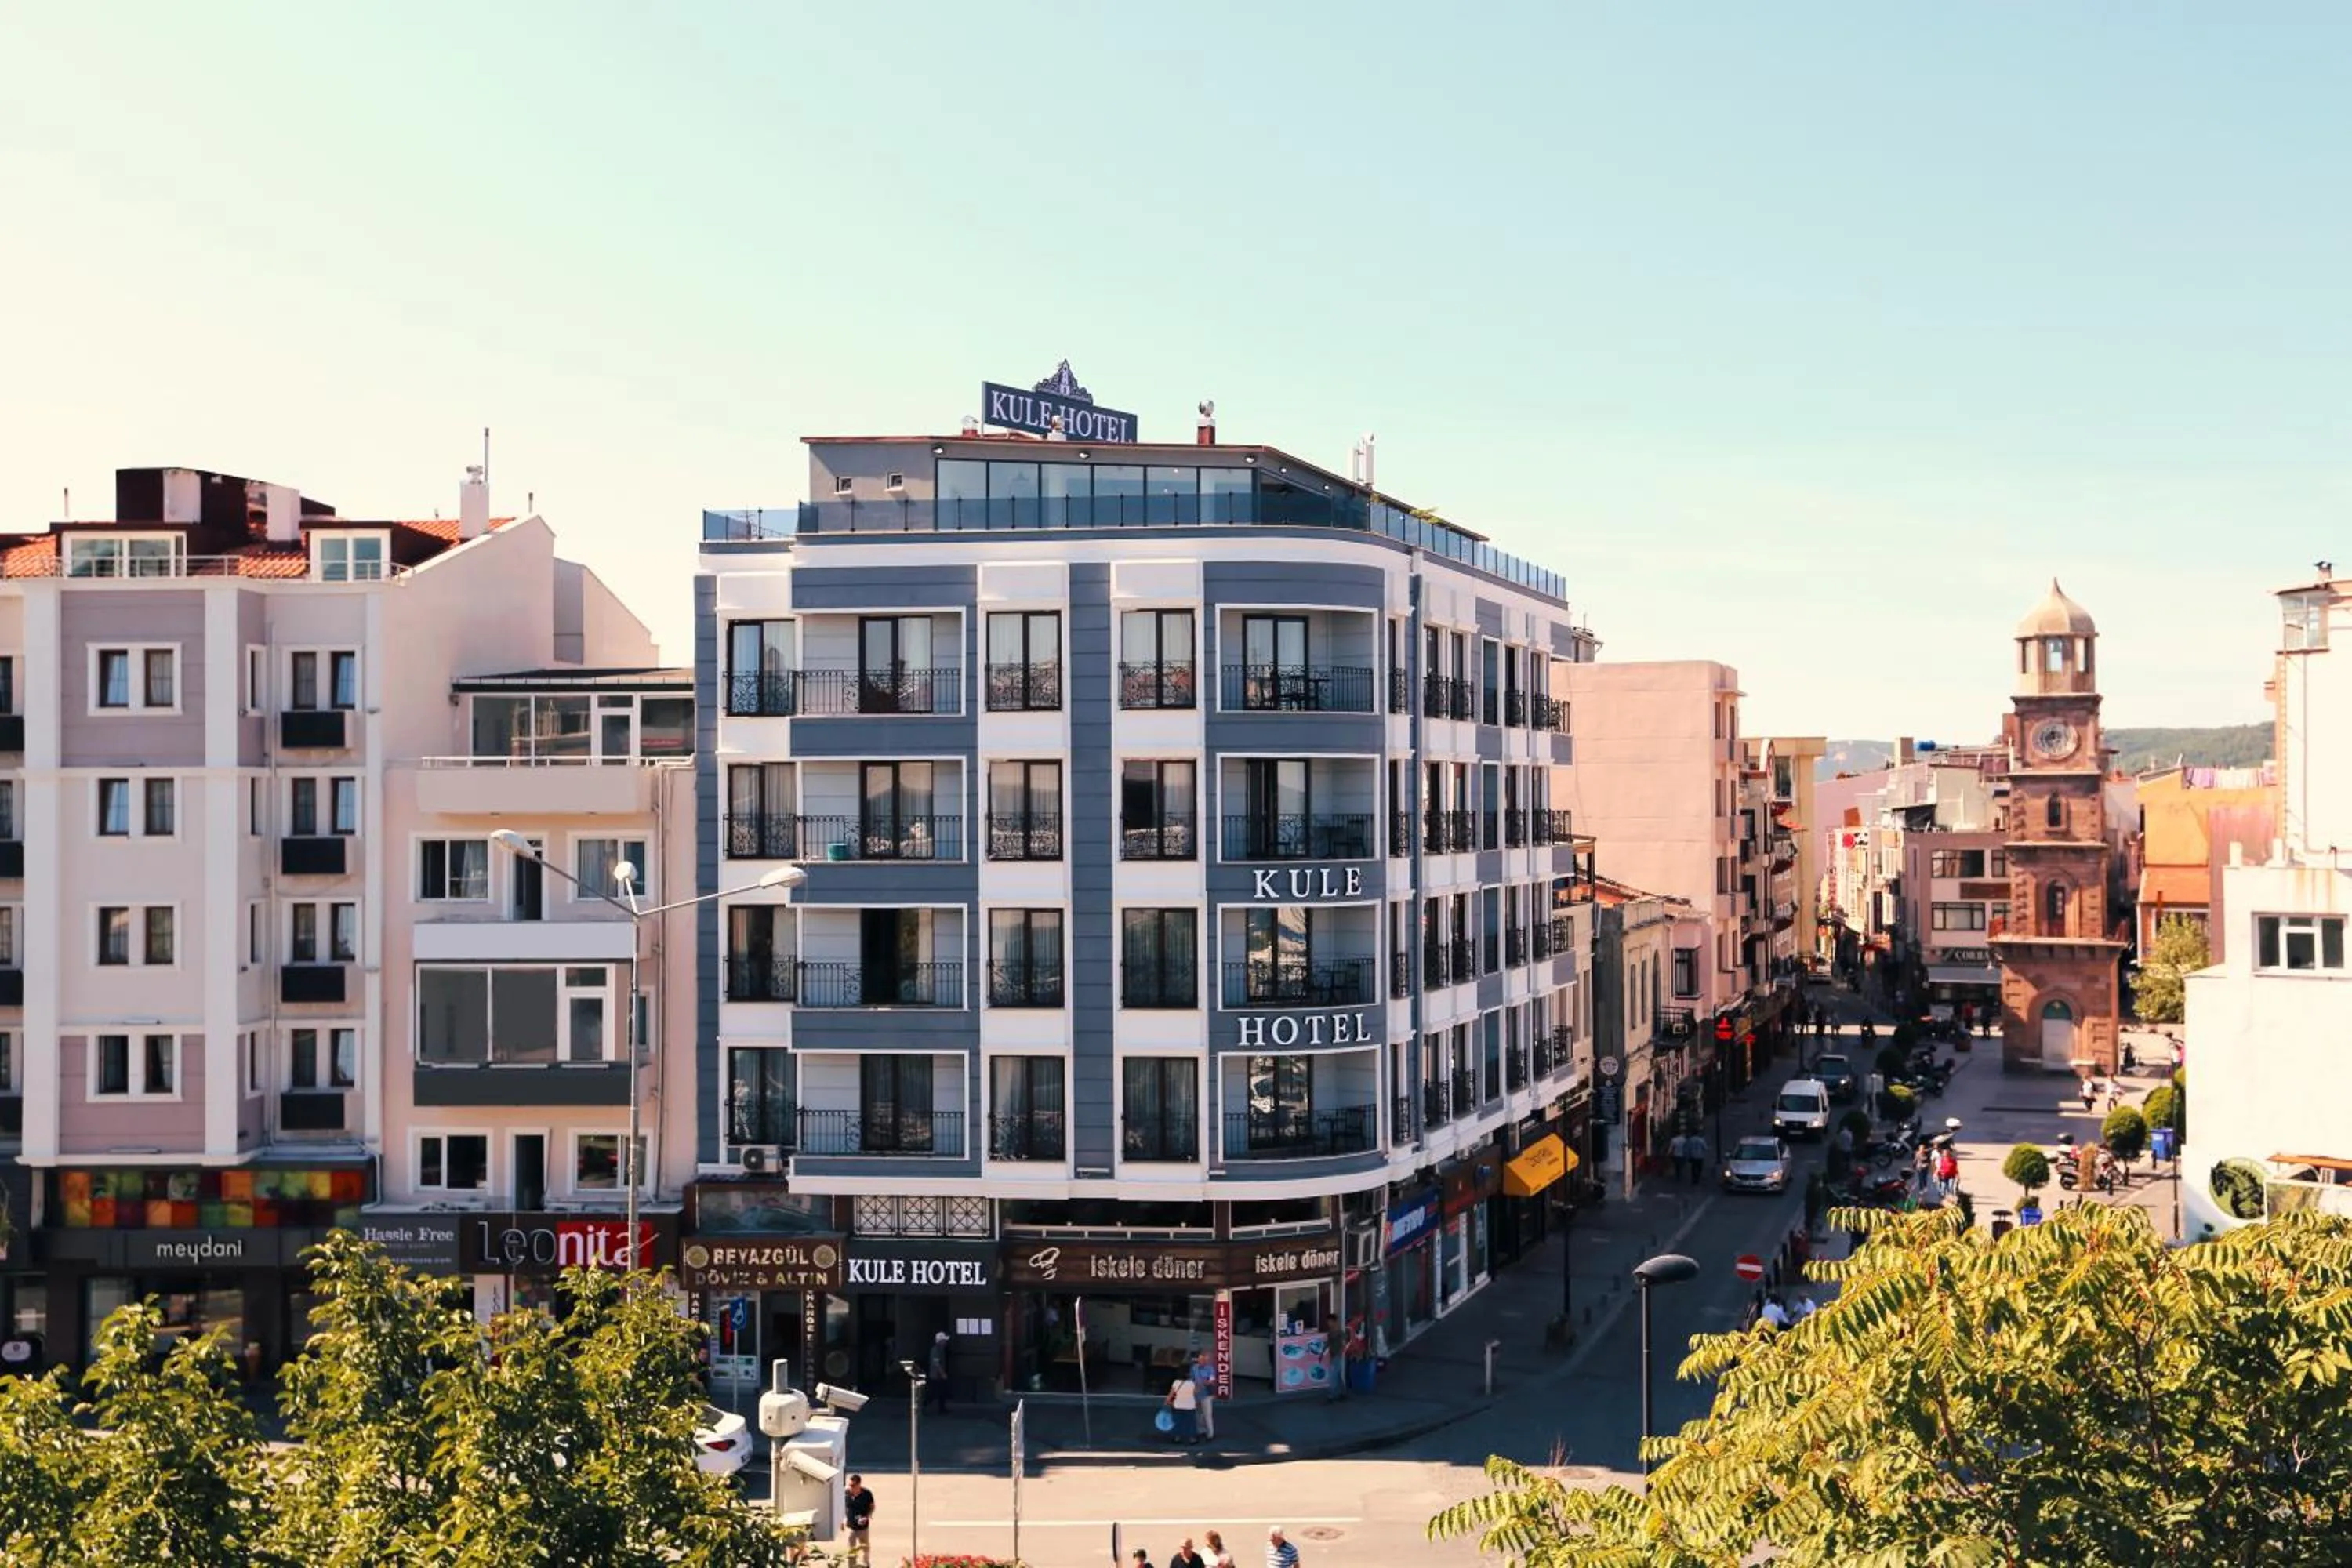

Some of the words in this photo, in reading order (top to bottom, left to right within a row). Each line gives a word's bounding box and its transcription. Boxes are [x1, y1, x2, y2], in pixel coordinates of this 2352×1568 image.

[992, 390, 1052, 430] KULE
[1058, 405, 1132, 443] HOTEL
[1253, 866, 1362, 898] KULE
[1237, 1013, 1371, 1047] HOTEL
[362, 1226, 413, 1242] Hassle
[417, 1226, 455, 1242] Free
[157, 1236, 242, 1264] meydani
[713, 1244, 810, 1265] BEYAZGÜL
[1255, 1252, 1298, 1274] iskele
[1301, 1248, 1340, 1269] döner
[775, 1271, 829, 1286] ALTIN
[848, 1258, 906, 1284] KULE
[910, 1260, 988, 1286] HOTEL
[1152, 1254, 1206, 1279] döner
